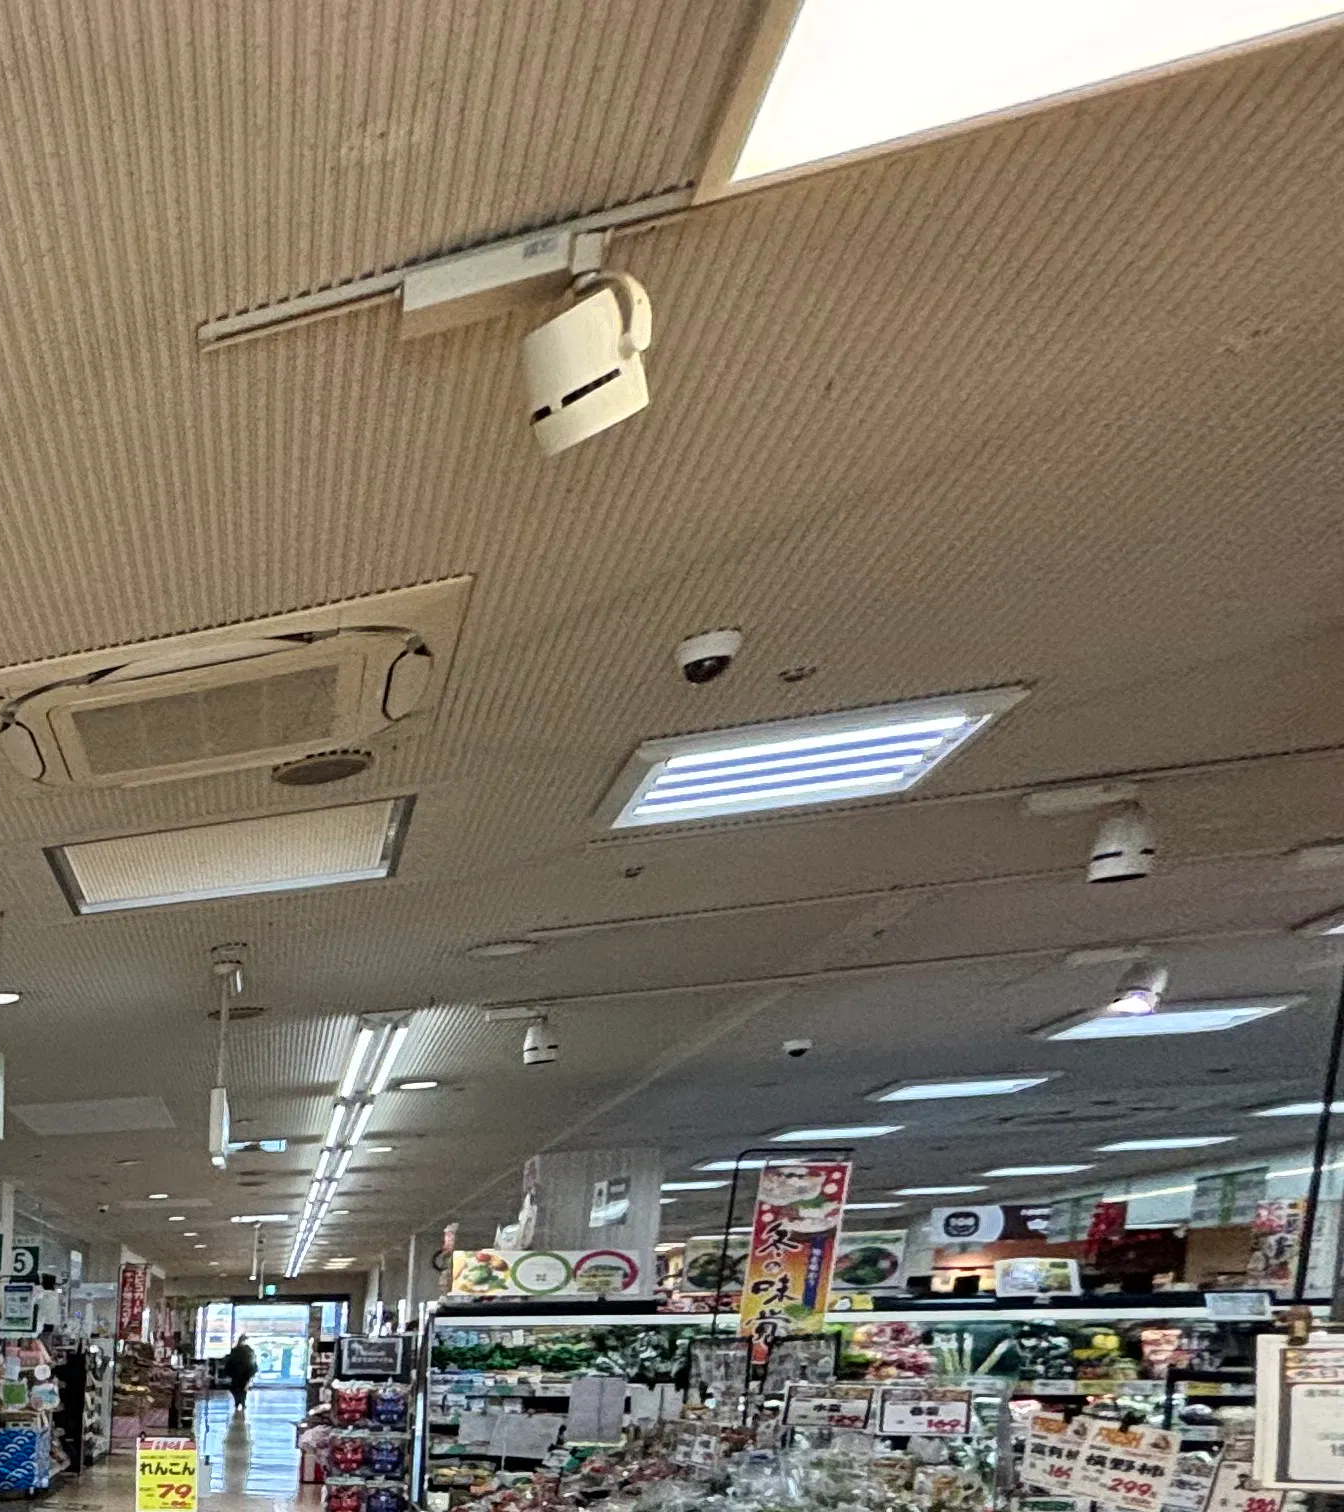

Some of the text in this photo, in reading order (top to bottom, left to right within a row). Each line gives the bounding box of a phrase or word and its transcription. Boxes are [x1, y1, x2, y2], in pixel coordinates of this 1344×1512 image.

[13, 1251, 26, 1274] 5
[139, 1461, 196, 1476] れんこん
[156, 1483, 192, 1500] 79
[1107, 1477, 1154, 1496] 299
